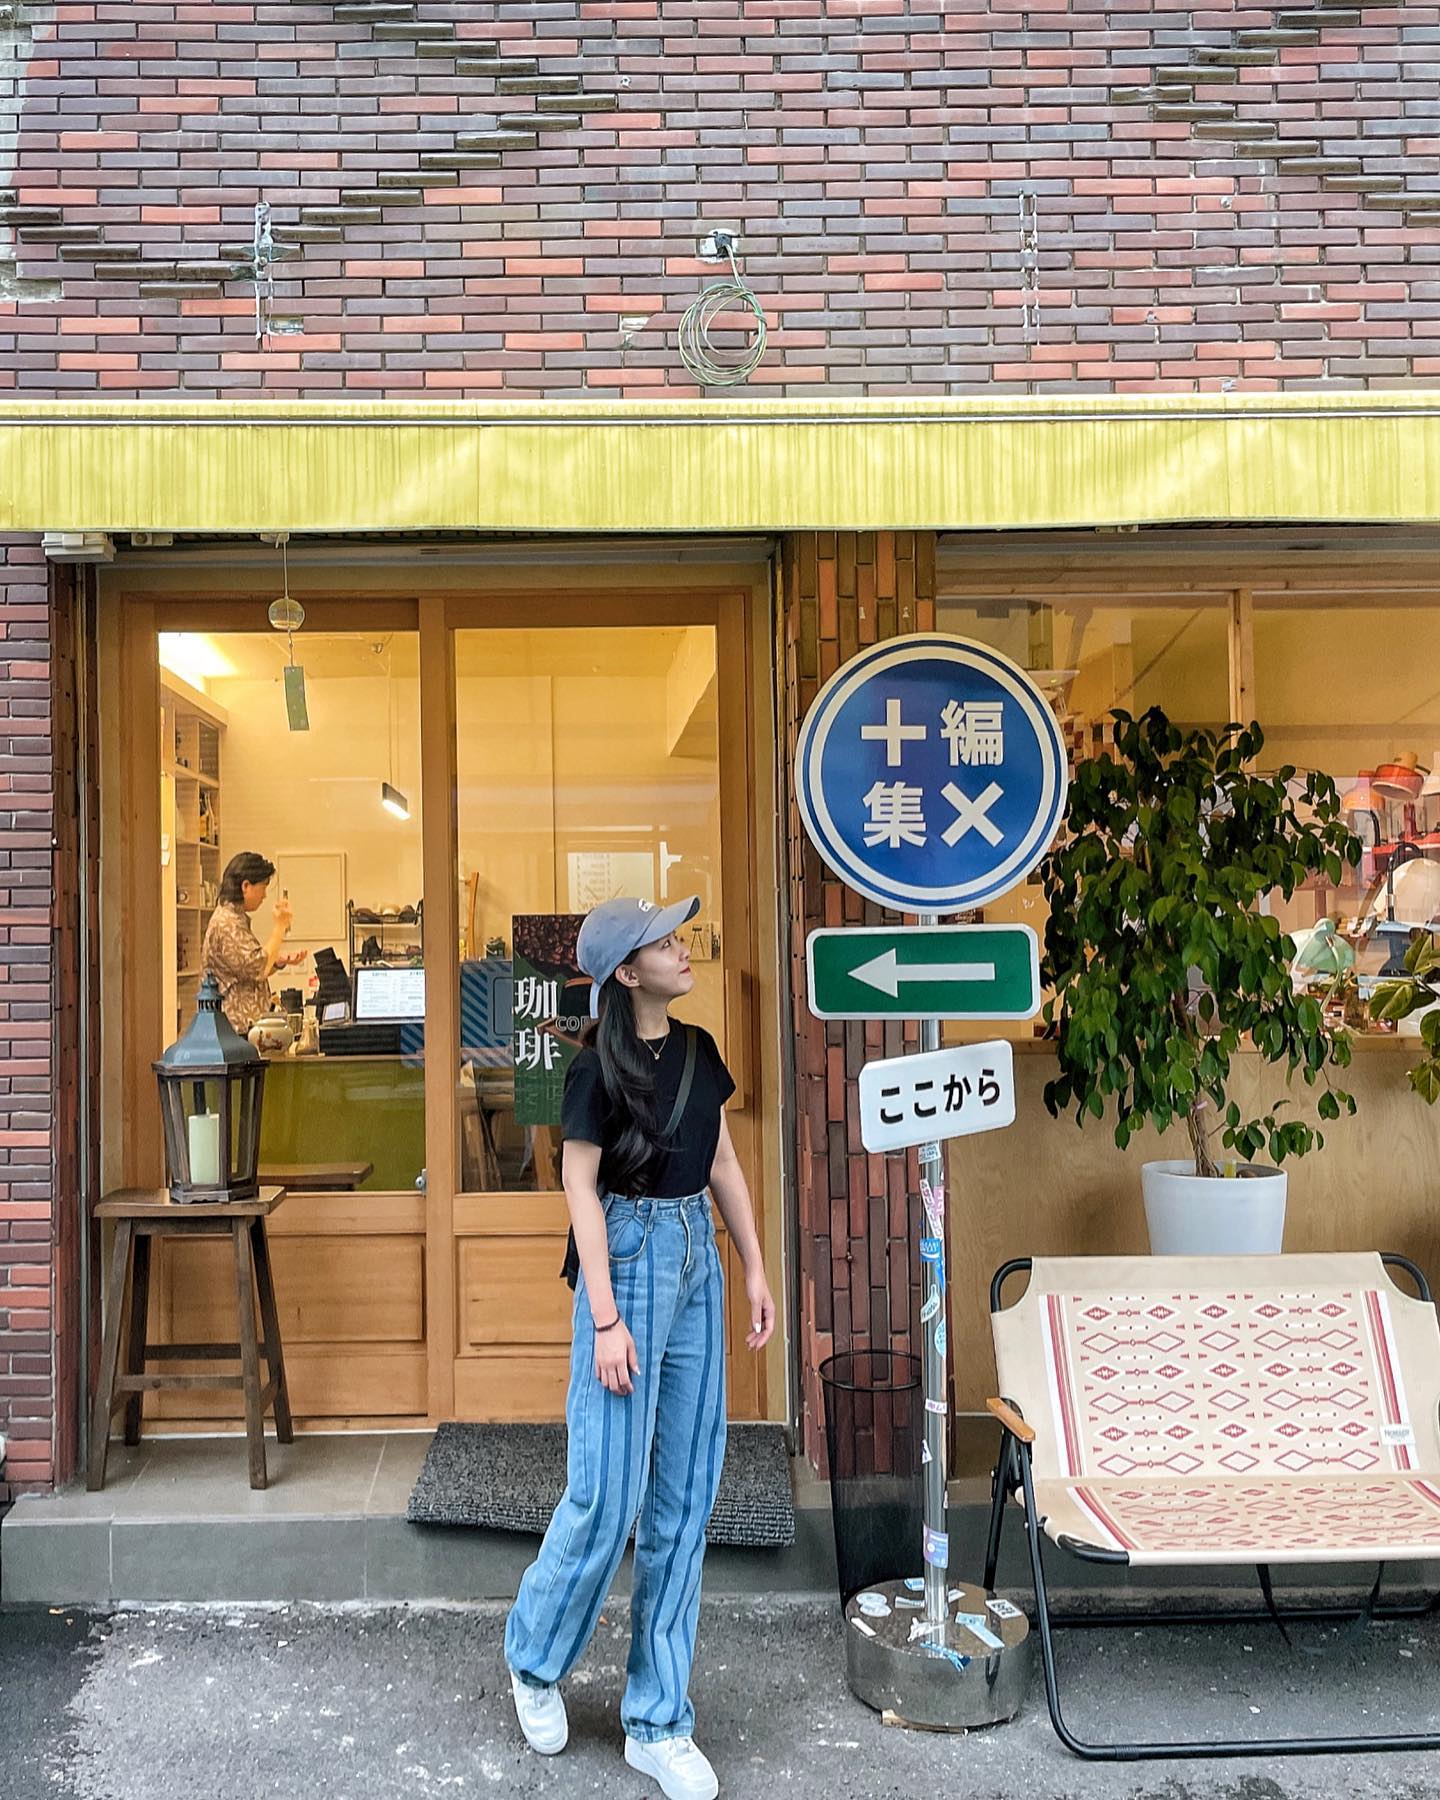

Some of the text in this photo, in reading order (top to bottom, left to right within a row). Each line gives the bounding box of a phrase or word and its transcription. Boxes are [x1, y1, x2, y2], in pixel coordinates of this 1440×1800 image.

[514, 976, 562, 1070] 珈琲
[880, 1068, 1000, 1124] ここから
